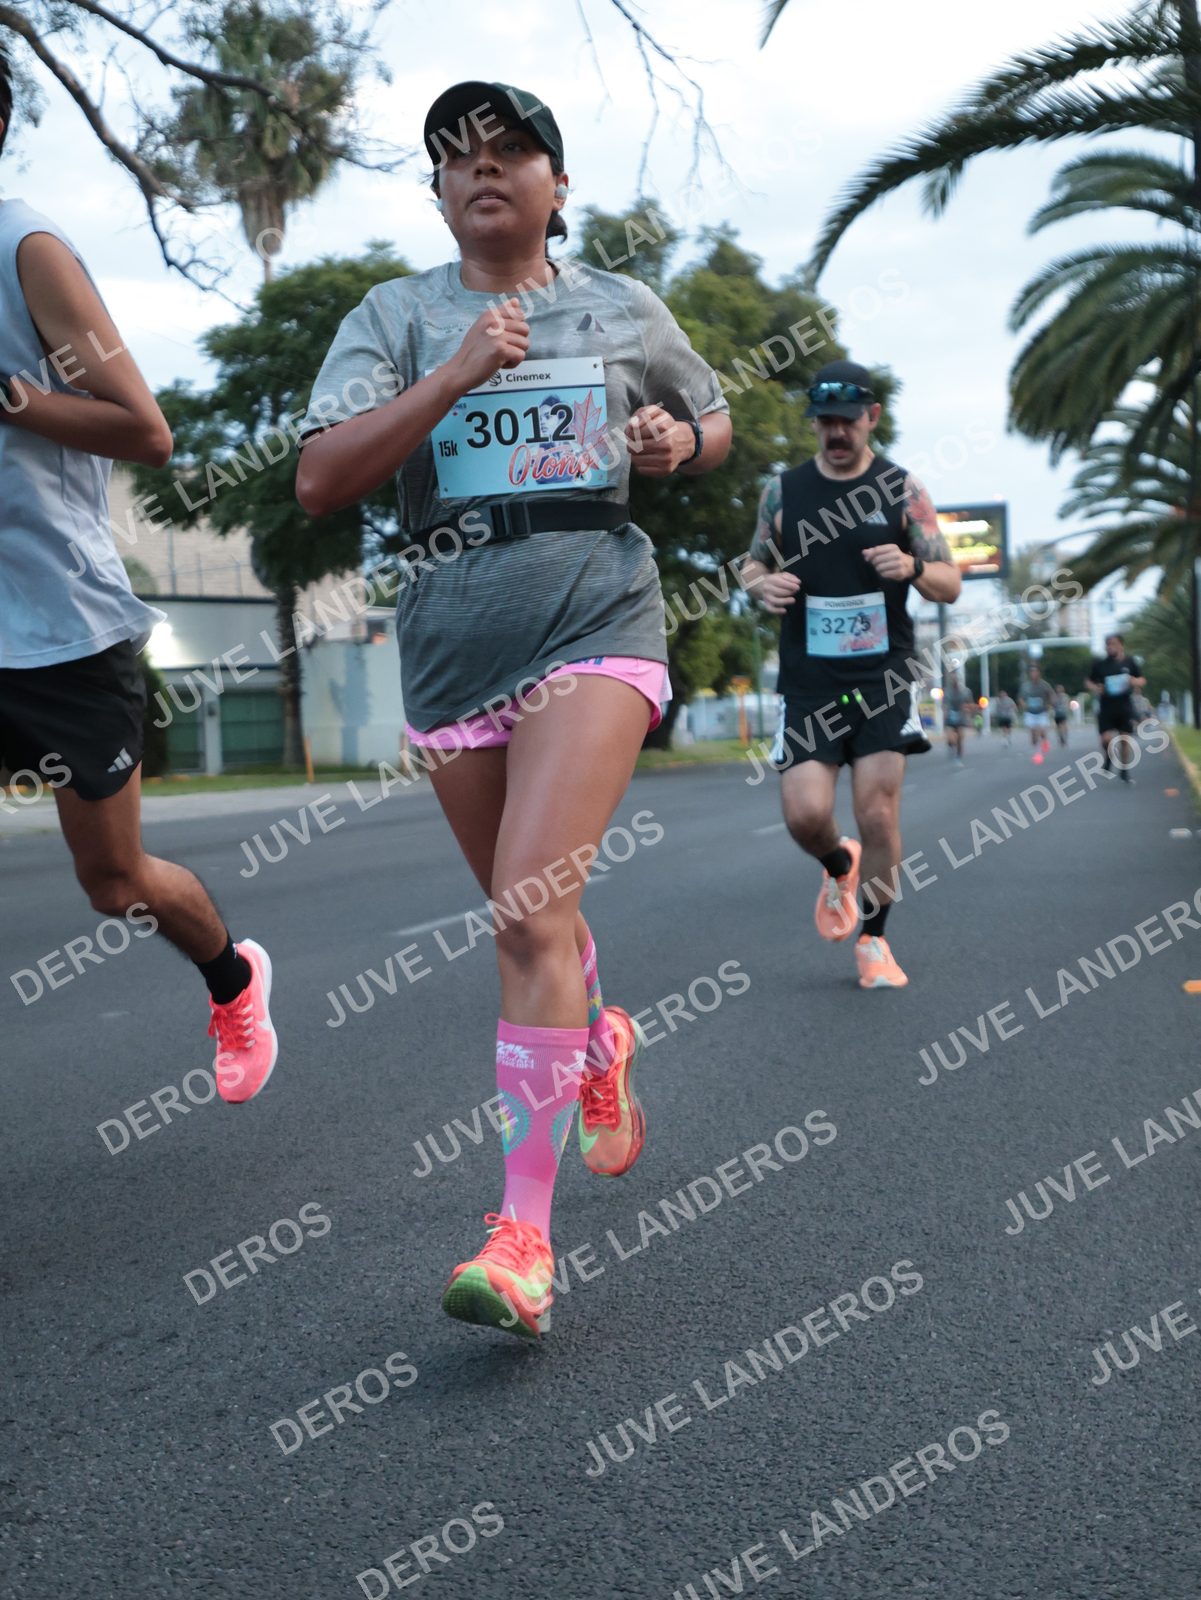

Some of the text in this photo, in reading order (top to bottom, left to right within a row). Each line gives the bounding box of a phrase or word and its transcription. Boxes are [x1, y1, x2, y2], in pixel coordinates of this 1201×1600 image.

[505, 372, 552, 383] Cinemex
[465, 404, 576, 449] 3012
[438, 440, 459, 457] 15k
